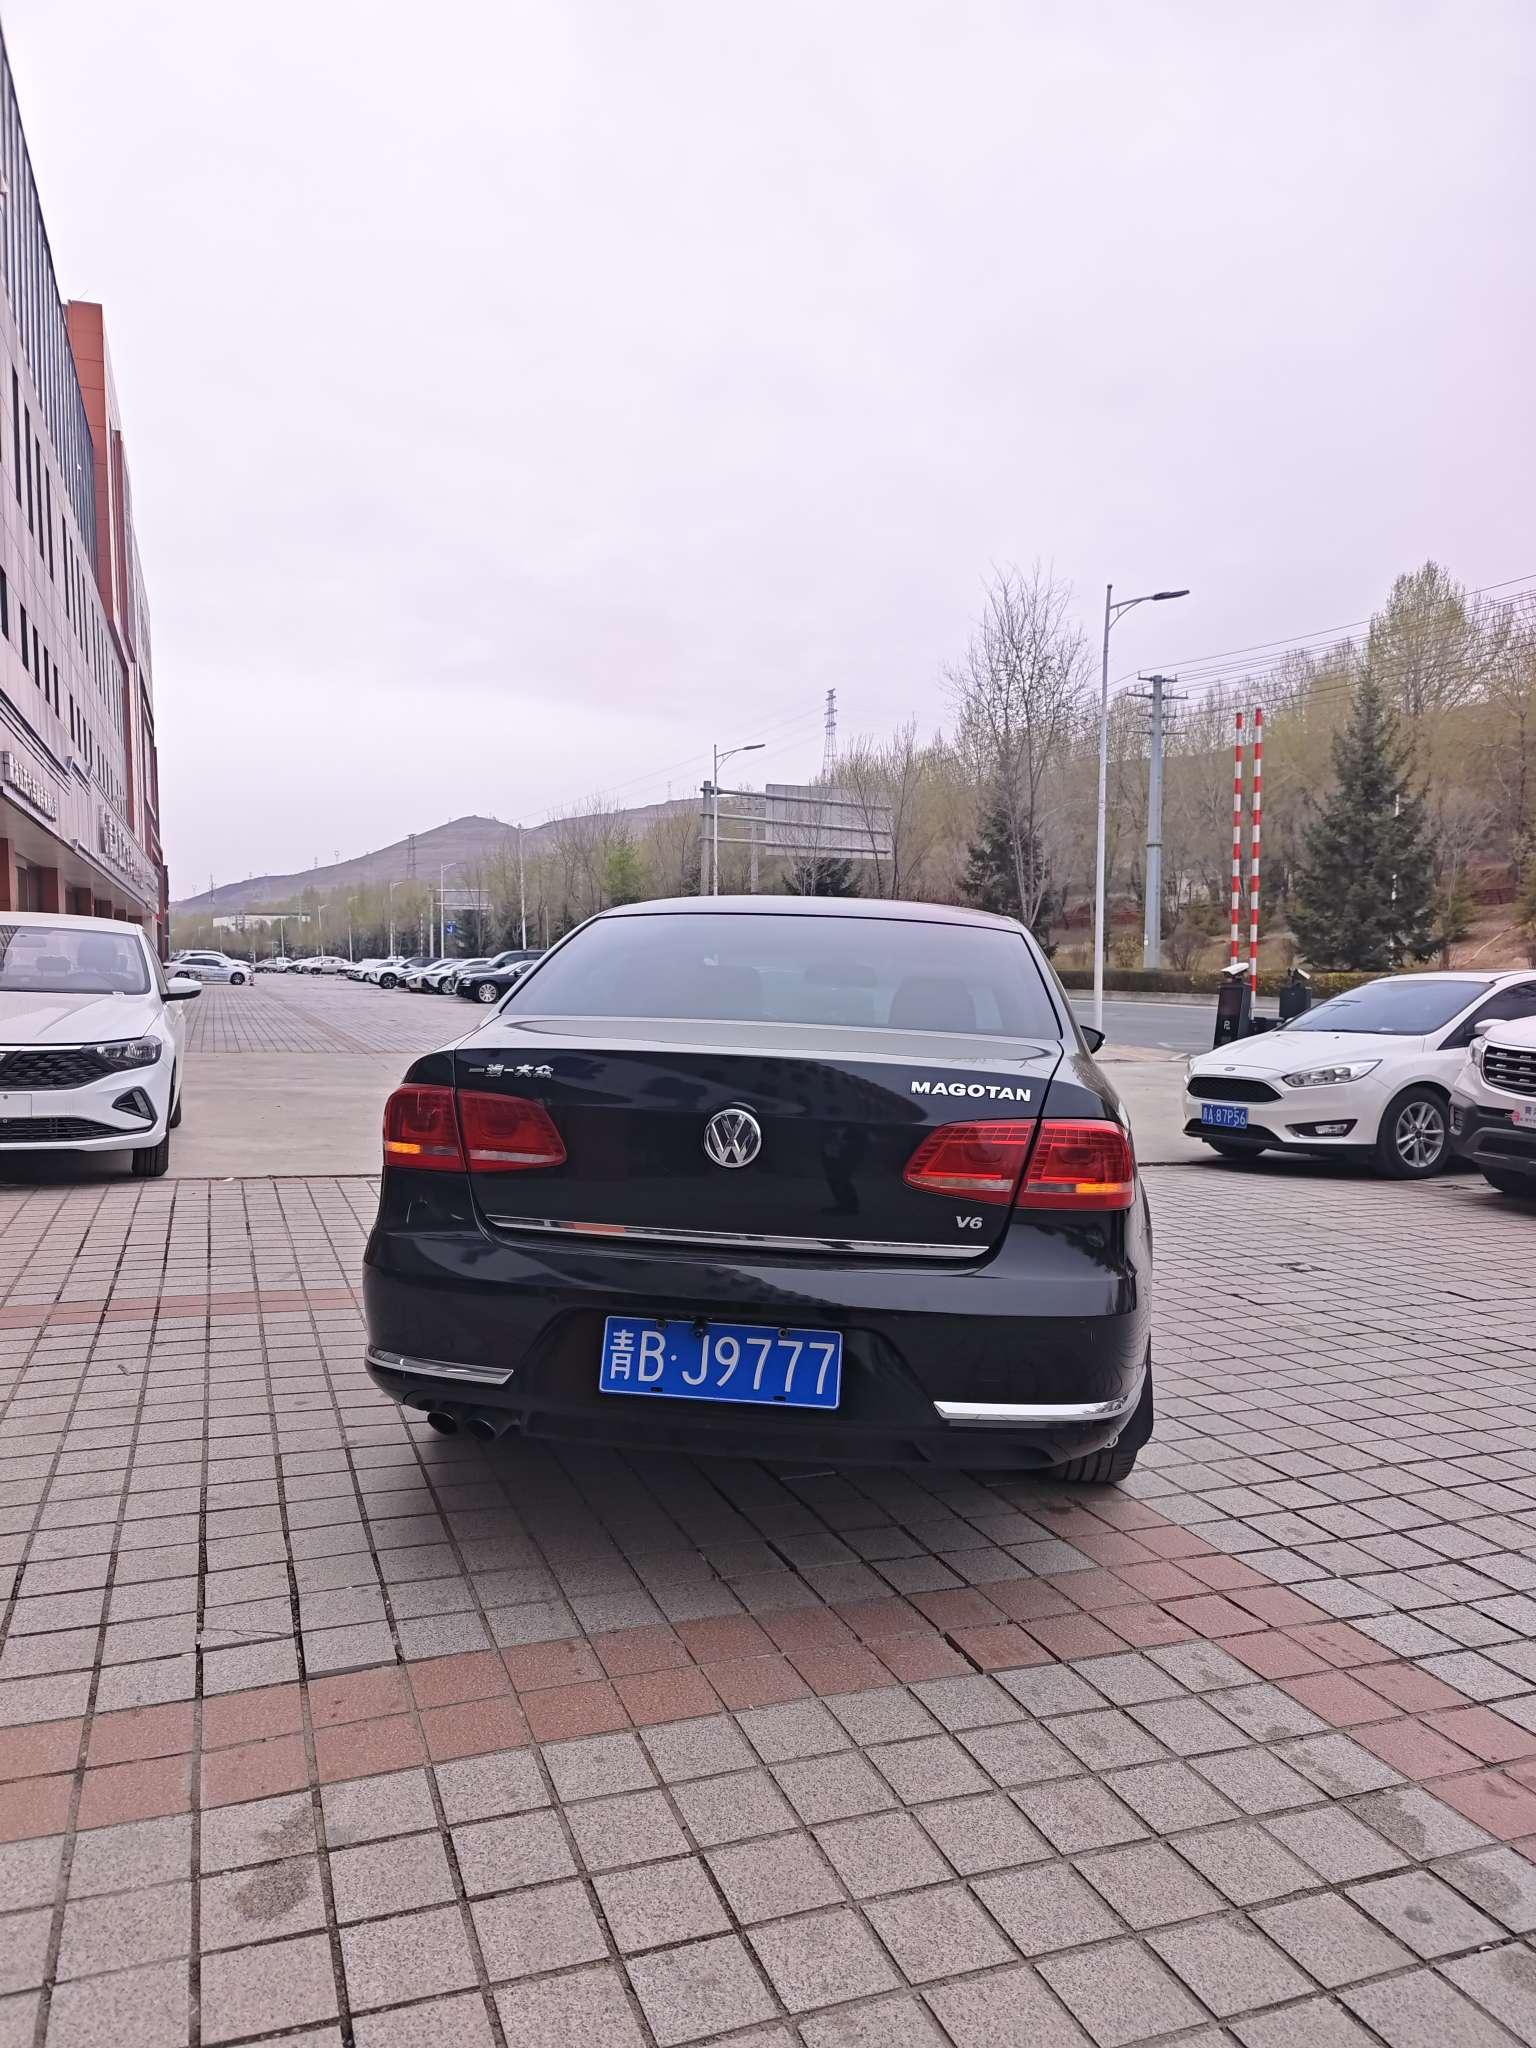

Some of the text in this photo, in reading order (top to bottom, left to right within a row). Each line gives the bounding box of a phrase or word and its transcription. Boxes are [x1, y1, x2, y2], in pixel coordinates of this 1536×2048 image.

[911, 1081, 1031, 1101] MAGOTAN
[956, 1216, 983, 1229] V6
[610, 1330, 835, 1395] 青B·J9777
